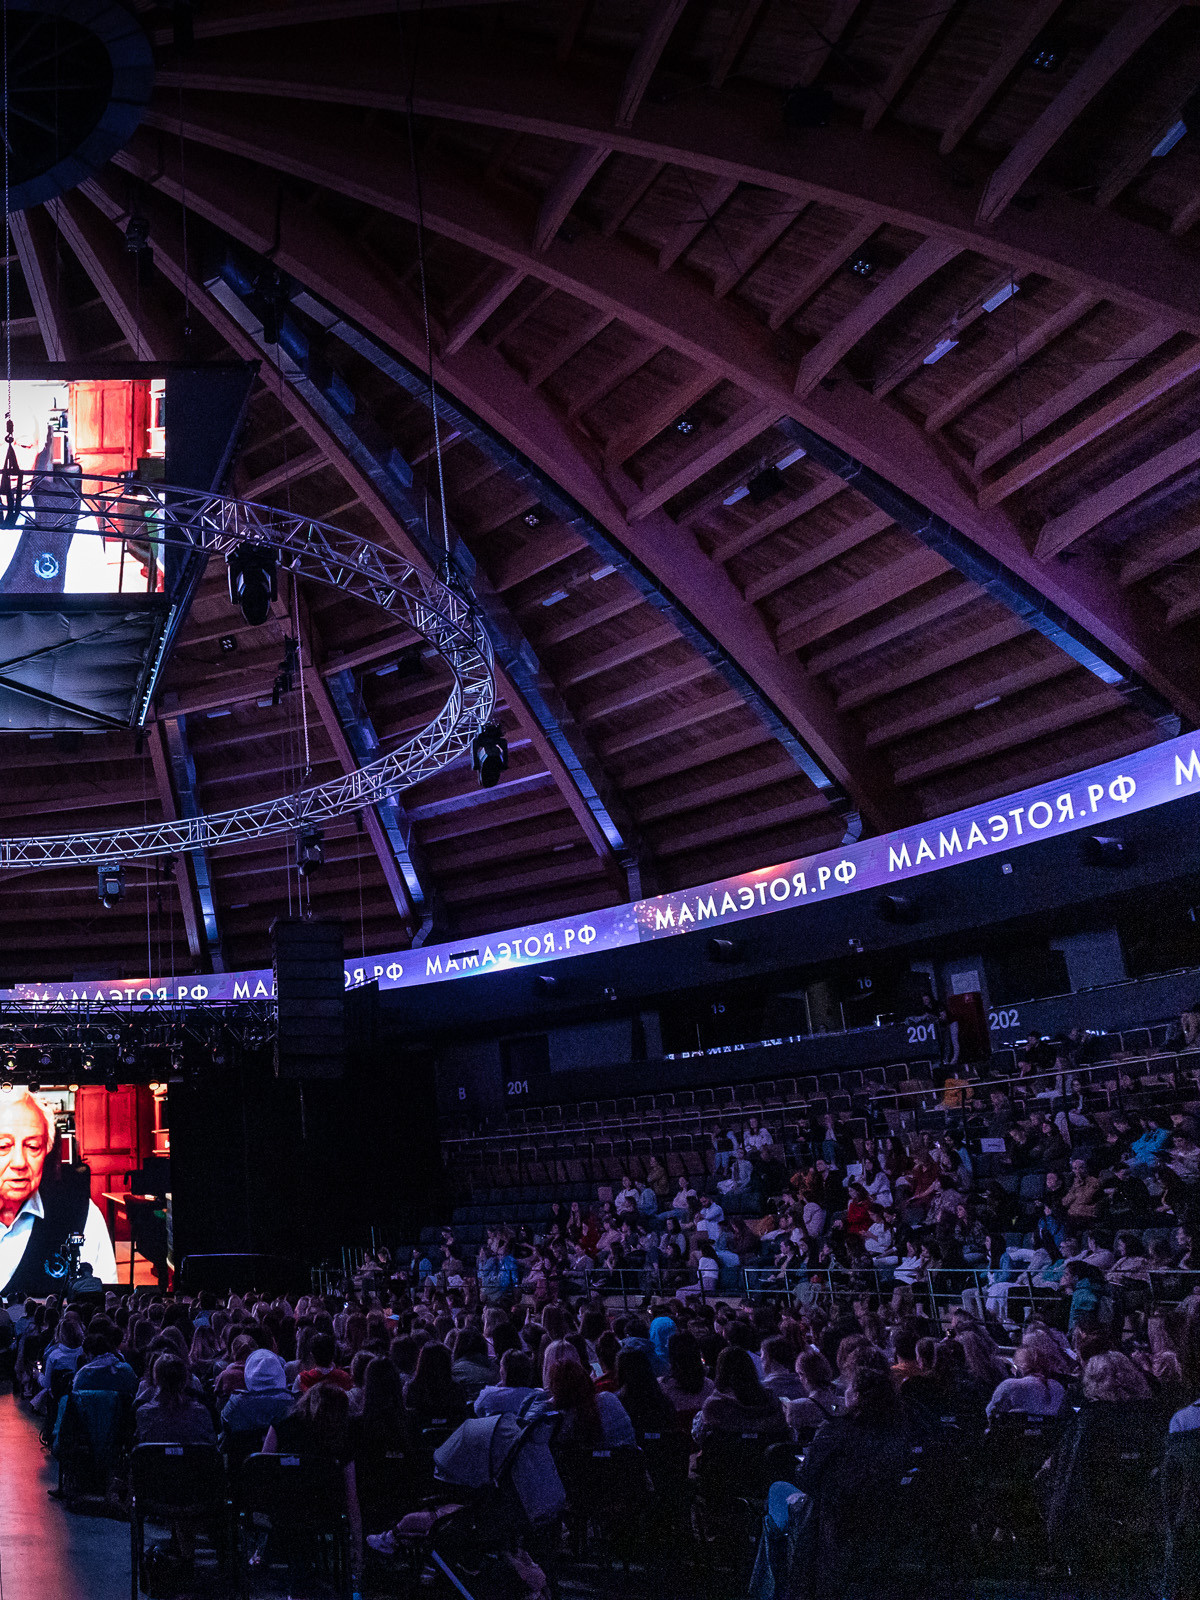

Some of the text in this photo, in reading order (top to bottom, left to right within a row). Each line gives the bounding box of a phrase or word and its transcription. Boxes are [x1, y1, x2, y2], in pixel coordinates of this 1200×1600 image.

[425, 924, 597, 976] МАМАЭТОЯ.РФ
[655, 860, 857, 930] МАМАЭТОЯ.РФ
[888, 774, 1137, 872] МАМАЭТОЯ.РФ
[711, 1003, 726, 1015] 15
[988, 1009, 1020, 1031] 202
[906, 1023, 936, 1044] 201
[507, 1080, 529, 1096] 201
